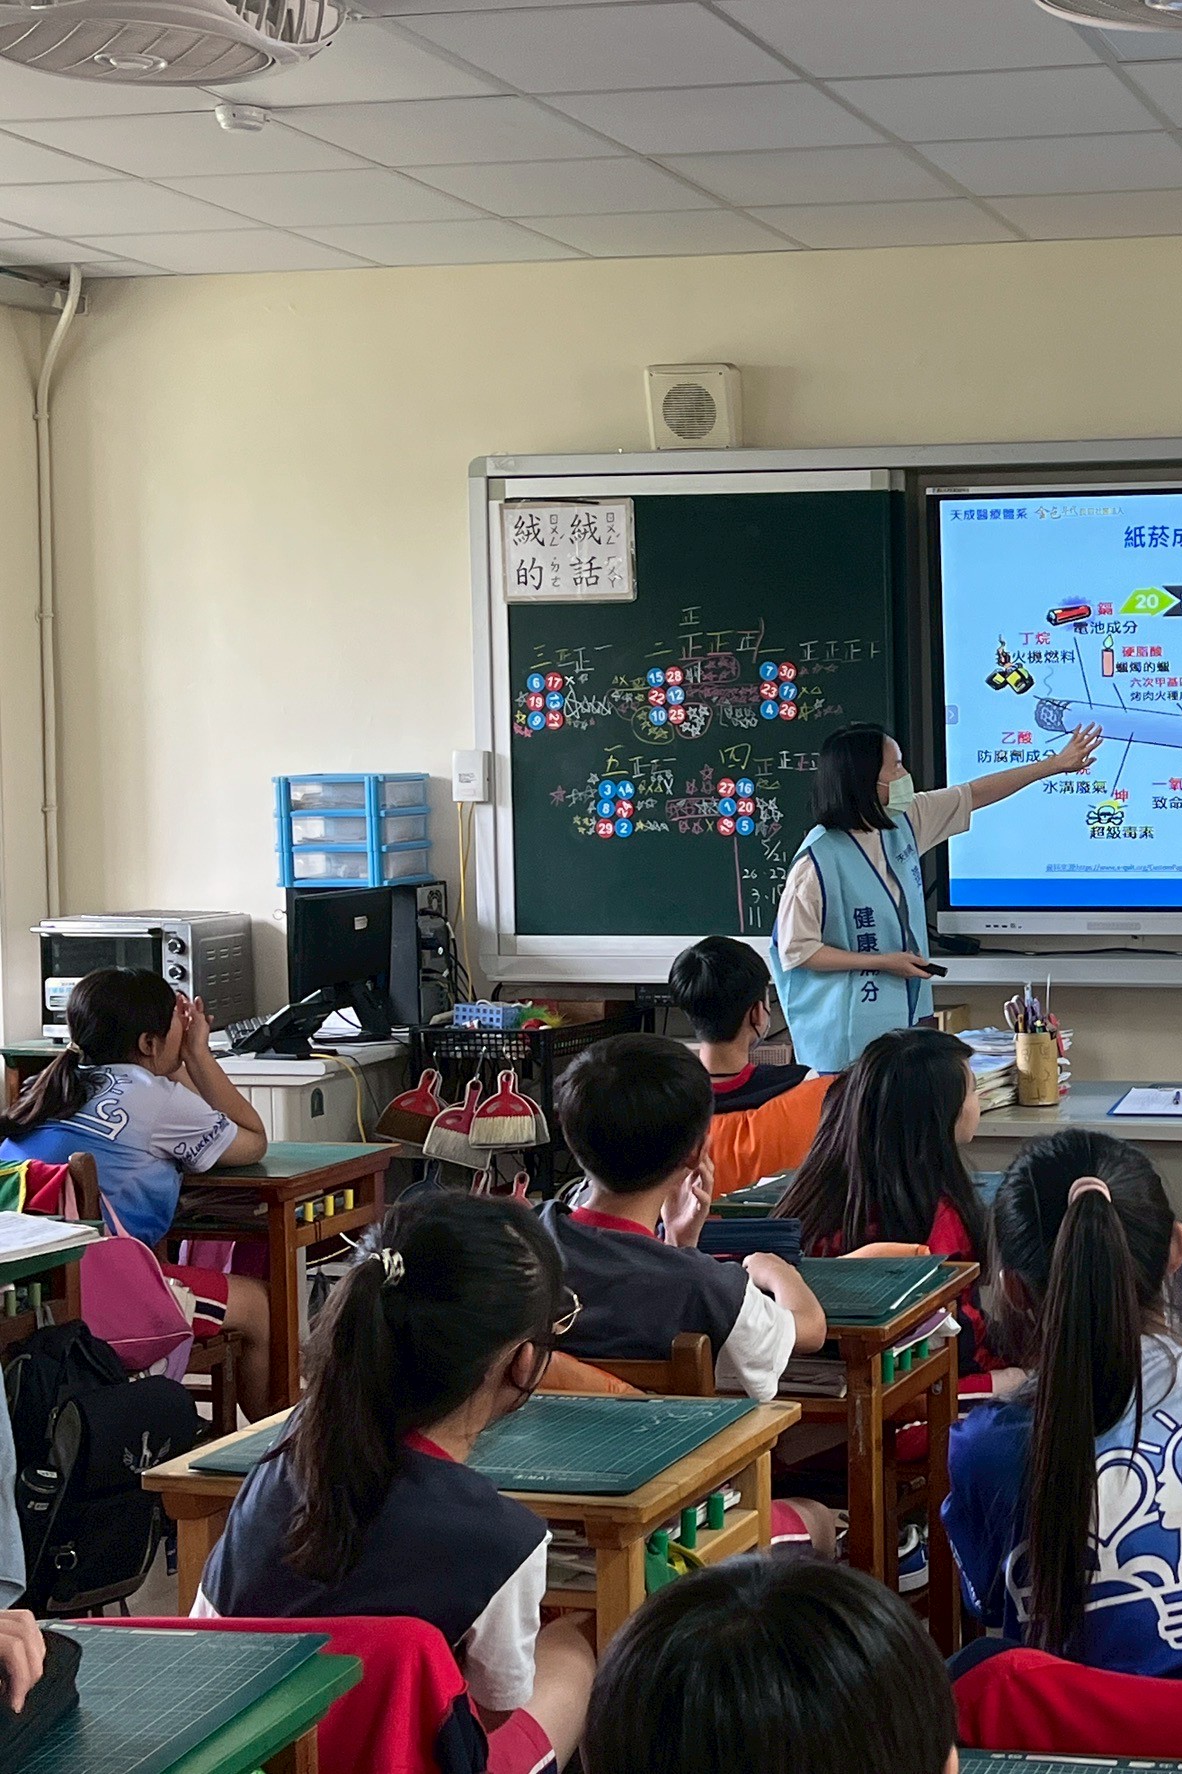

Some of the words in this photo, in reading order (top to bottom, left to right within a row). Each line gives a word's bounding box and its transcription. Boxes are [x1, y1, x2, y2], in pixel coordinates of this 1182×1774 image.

[950, 507, 1028, 521] 天成醫療體系
[1135, 594, 1159, 610] 20
[1073, 620, 1138, 635] 電池成分
[1001, 731, 1032, 745] 乙酸
[1042, 780, 1108, 794] 水溝廢氣
[1089, 826, 1154, 839] 超級毒素
